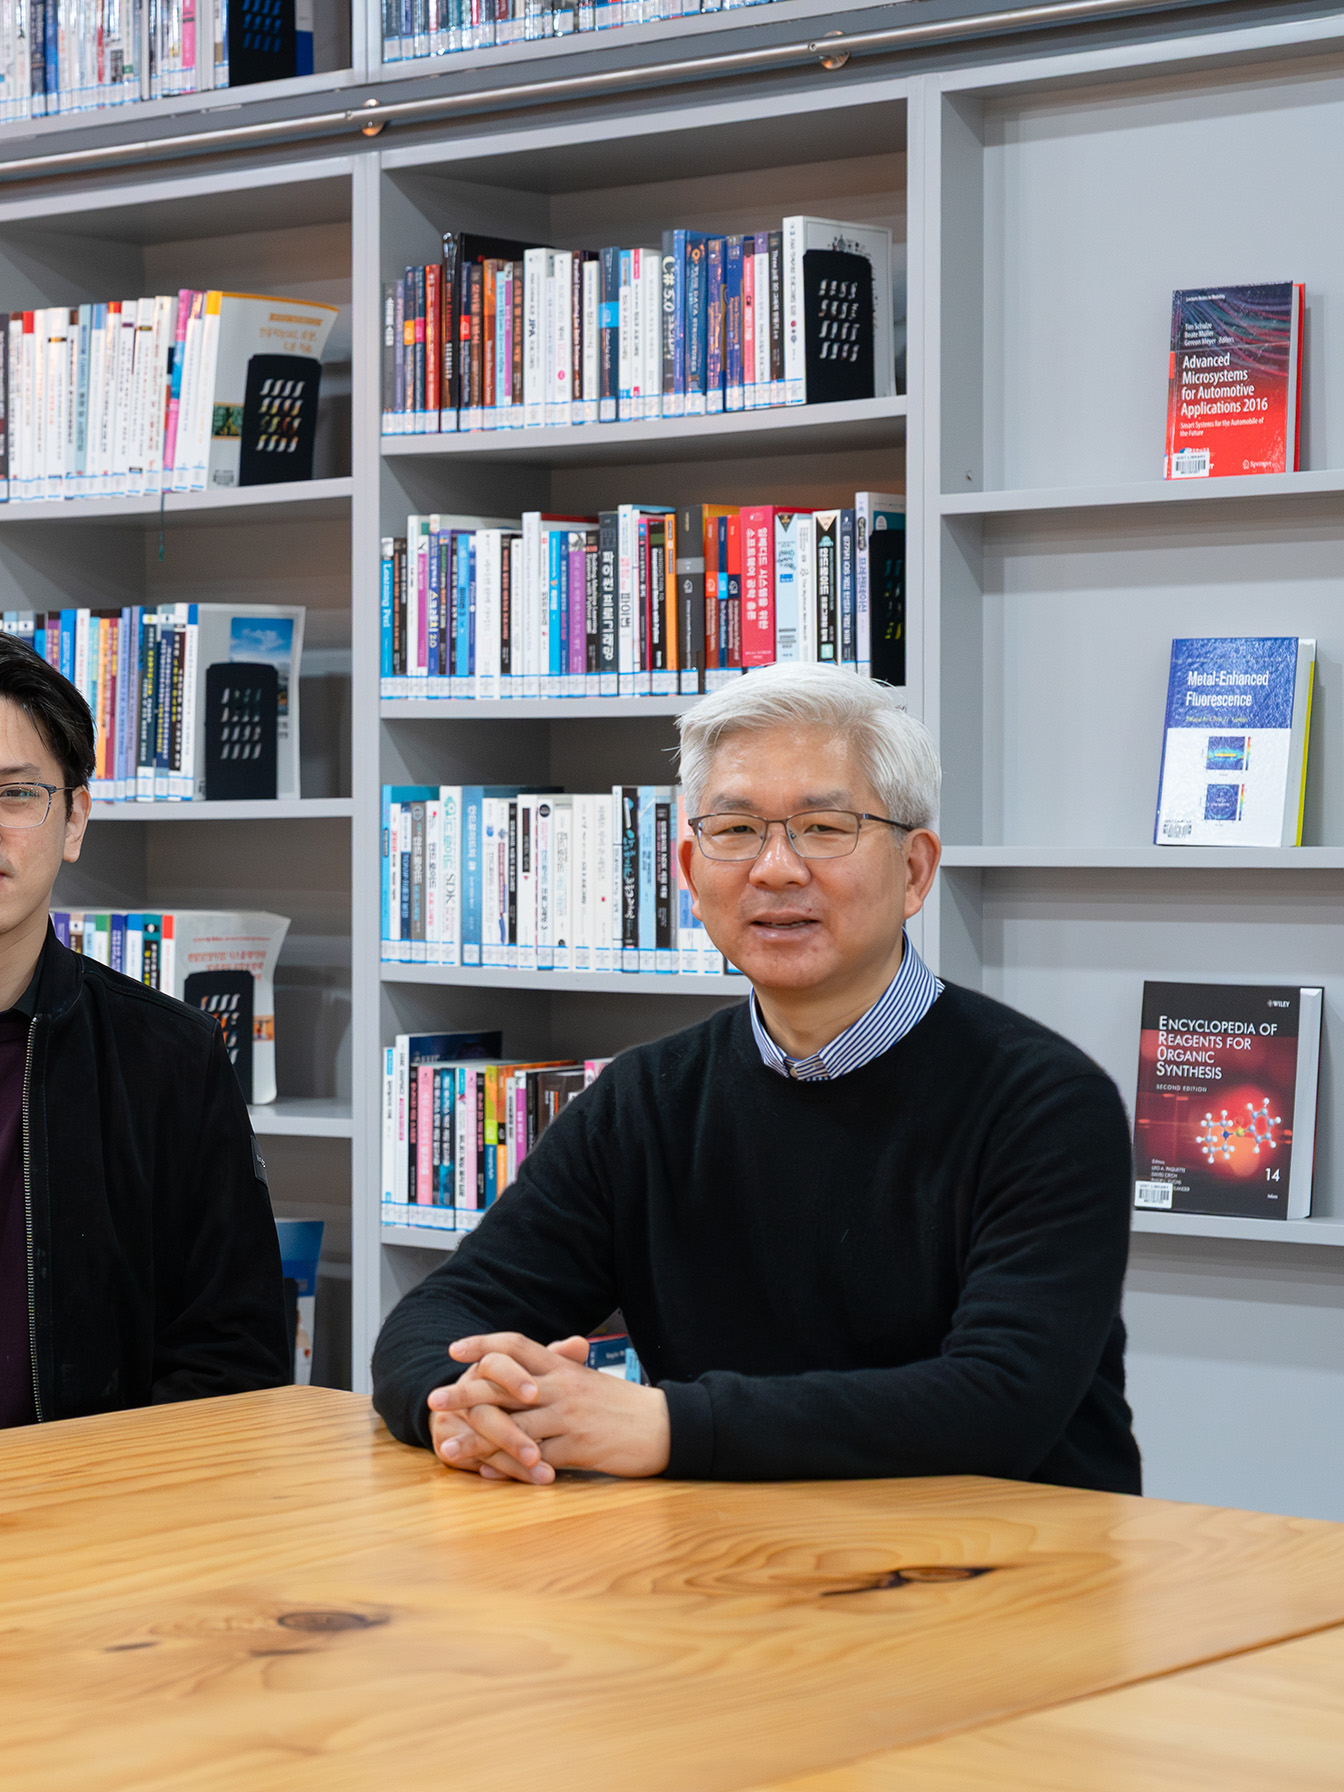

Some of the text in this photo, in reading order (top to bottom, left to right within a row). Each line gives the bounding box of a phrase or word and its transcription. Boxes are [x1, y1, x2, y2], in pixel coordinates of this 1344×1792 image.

[663, 256, 675, 286] C#
[572, 284, 581, 317] Computing
[663, 288, 675, 312] 5.0
[528, 318, 539, 337] JPA
[691, 292, 700, 371] DATA STRUCTURES
[1183, 352, 1230, 369] Advanced
[1182, 370, 1248, 386] Microsystems
[1182, 384, 1254, 401] for Automotive
[1181, 397, 1268, 418] Applications 2016
[1195, 421, 1214, 429] Systems
[1222, 419, 1230, 427] the
[1231, 418, 1258, 426] Automobile
[1251, 461, 1271, 469] Springer
[747, 528, 757, 576] 소프트웨어
[758, 527, 768, 629] 임베디드 시스템을 위한
[819, 547, 830, 595] 안드로이드
[747, 579, 757, 598] 공학
[858, 557, 867, 612] 프레젠테이션
[381, 563, 391, 627] Learning Perl
[602, 551, 614, 661] 파이썬 프로그래밍
[820, 596, 828, 628] 프로그래밍
[429, 590, 439, 648] 스크래치 2.0
[719, 609, 727, 625] Python
[651, 624, 659, 644] Python
[1188, 671, 1269, 687] Metal-Enhanced
[1186, 691, 1252, 707] Fluorescence
[468, 805, 477, 857] 안드로이드의
[446, 874, 456, 904] SDK
[1272, 1000, 1290, 1008] WILEY
[1159, 1016, 1278, 1036] ENCYCLOPEDIA OF
[1158, 1031, 1252, 1051] REAGENTS FOR
[1157, 1046, 1215, 1064] ORGANIC
[1156, 1061, 1223, 1080] SYNTHESIS
[1156, 1084, 1208, 1093] SECOND EDITION
[1265, 1168, 1281, 1183] 14
